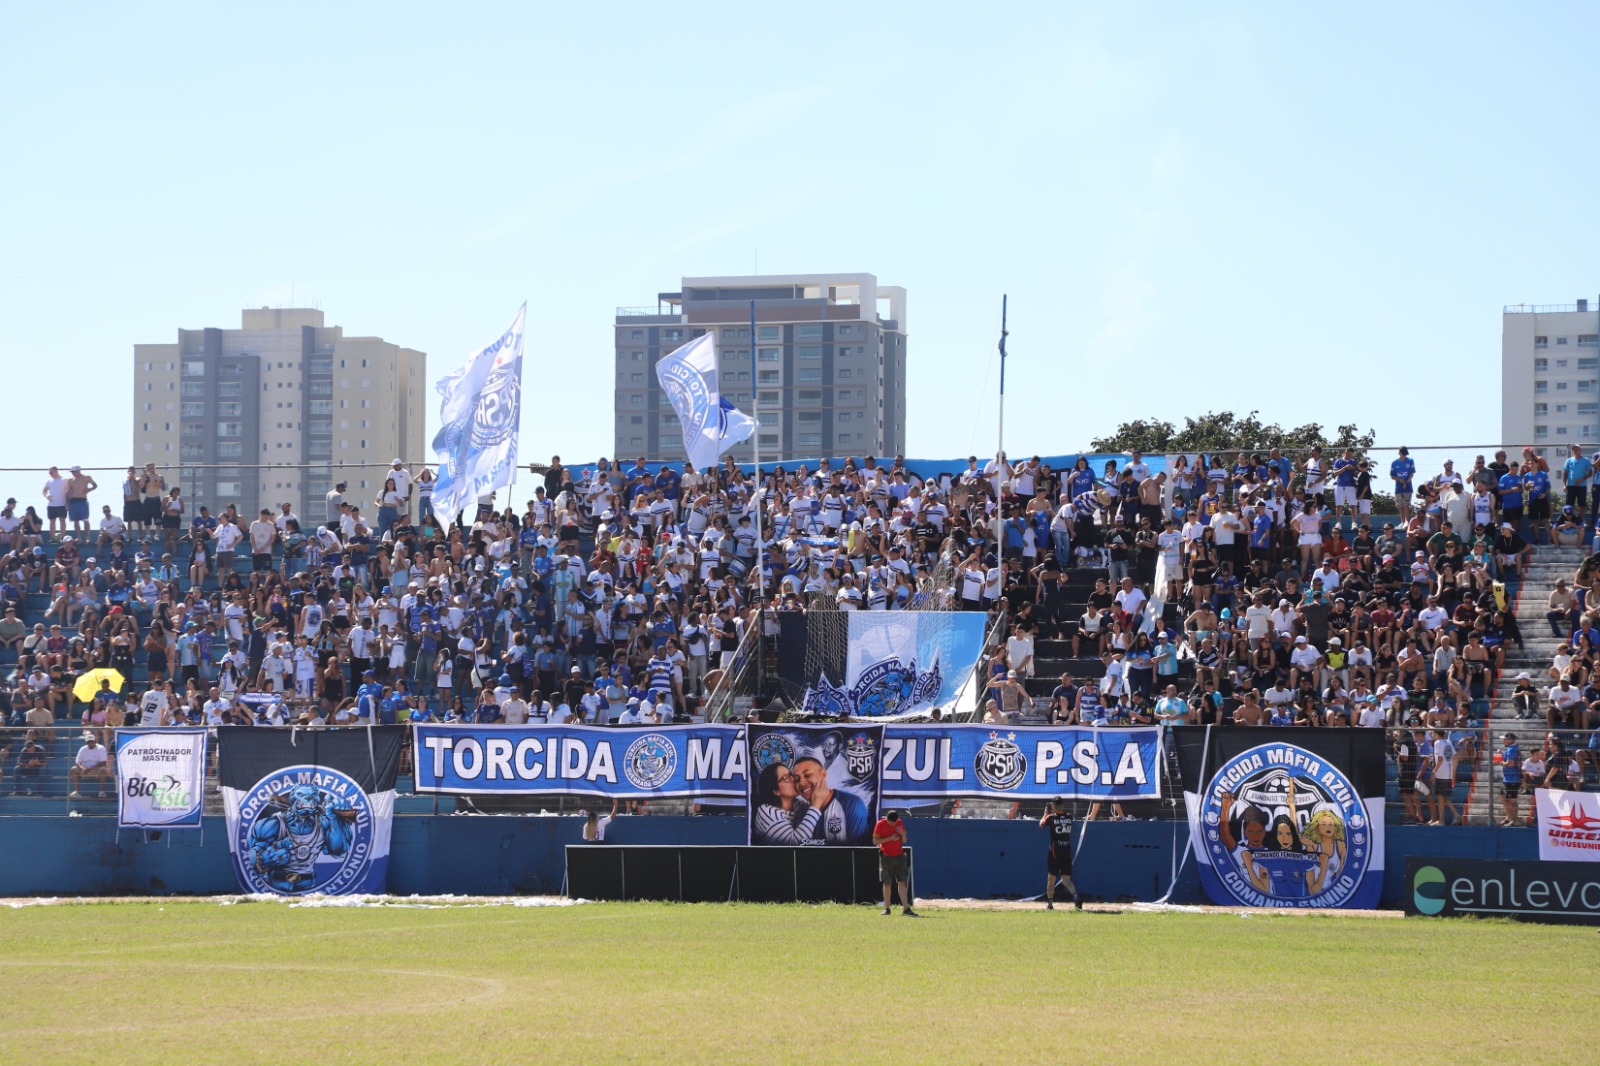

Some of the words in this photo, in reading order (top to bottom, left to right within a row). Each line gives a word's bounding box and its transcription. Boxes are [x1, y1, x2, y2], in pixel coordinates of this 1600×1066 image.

[145, 702, 158, 714] 12
[127, 748, 192, 756] PATROCINADOR
[424, 736, 619, 784] TORCIDA
[685, 729, 746, 781] MÁ
[883, 737, 965, 781] ZUL
[1034, 739, 1148, 784] P.S.A
[627, 738, 647, 760] TORCIDA
[849, 756, 872, 774] PSA
[986, 751, 1014, 778] PSA
[297, 772, 348, 797] MAFIA
[1210, 753, 1264, 807] TORCIDA
[1266, 748, 1320, 776] MÁFIA
[1321, 771, 1355, 813] AZUL
[800, 838, 826, 846] SOMOS
[1548, 829, 1600, 841] UNIE
